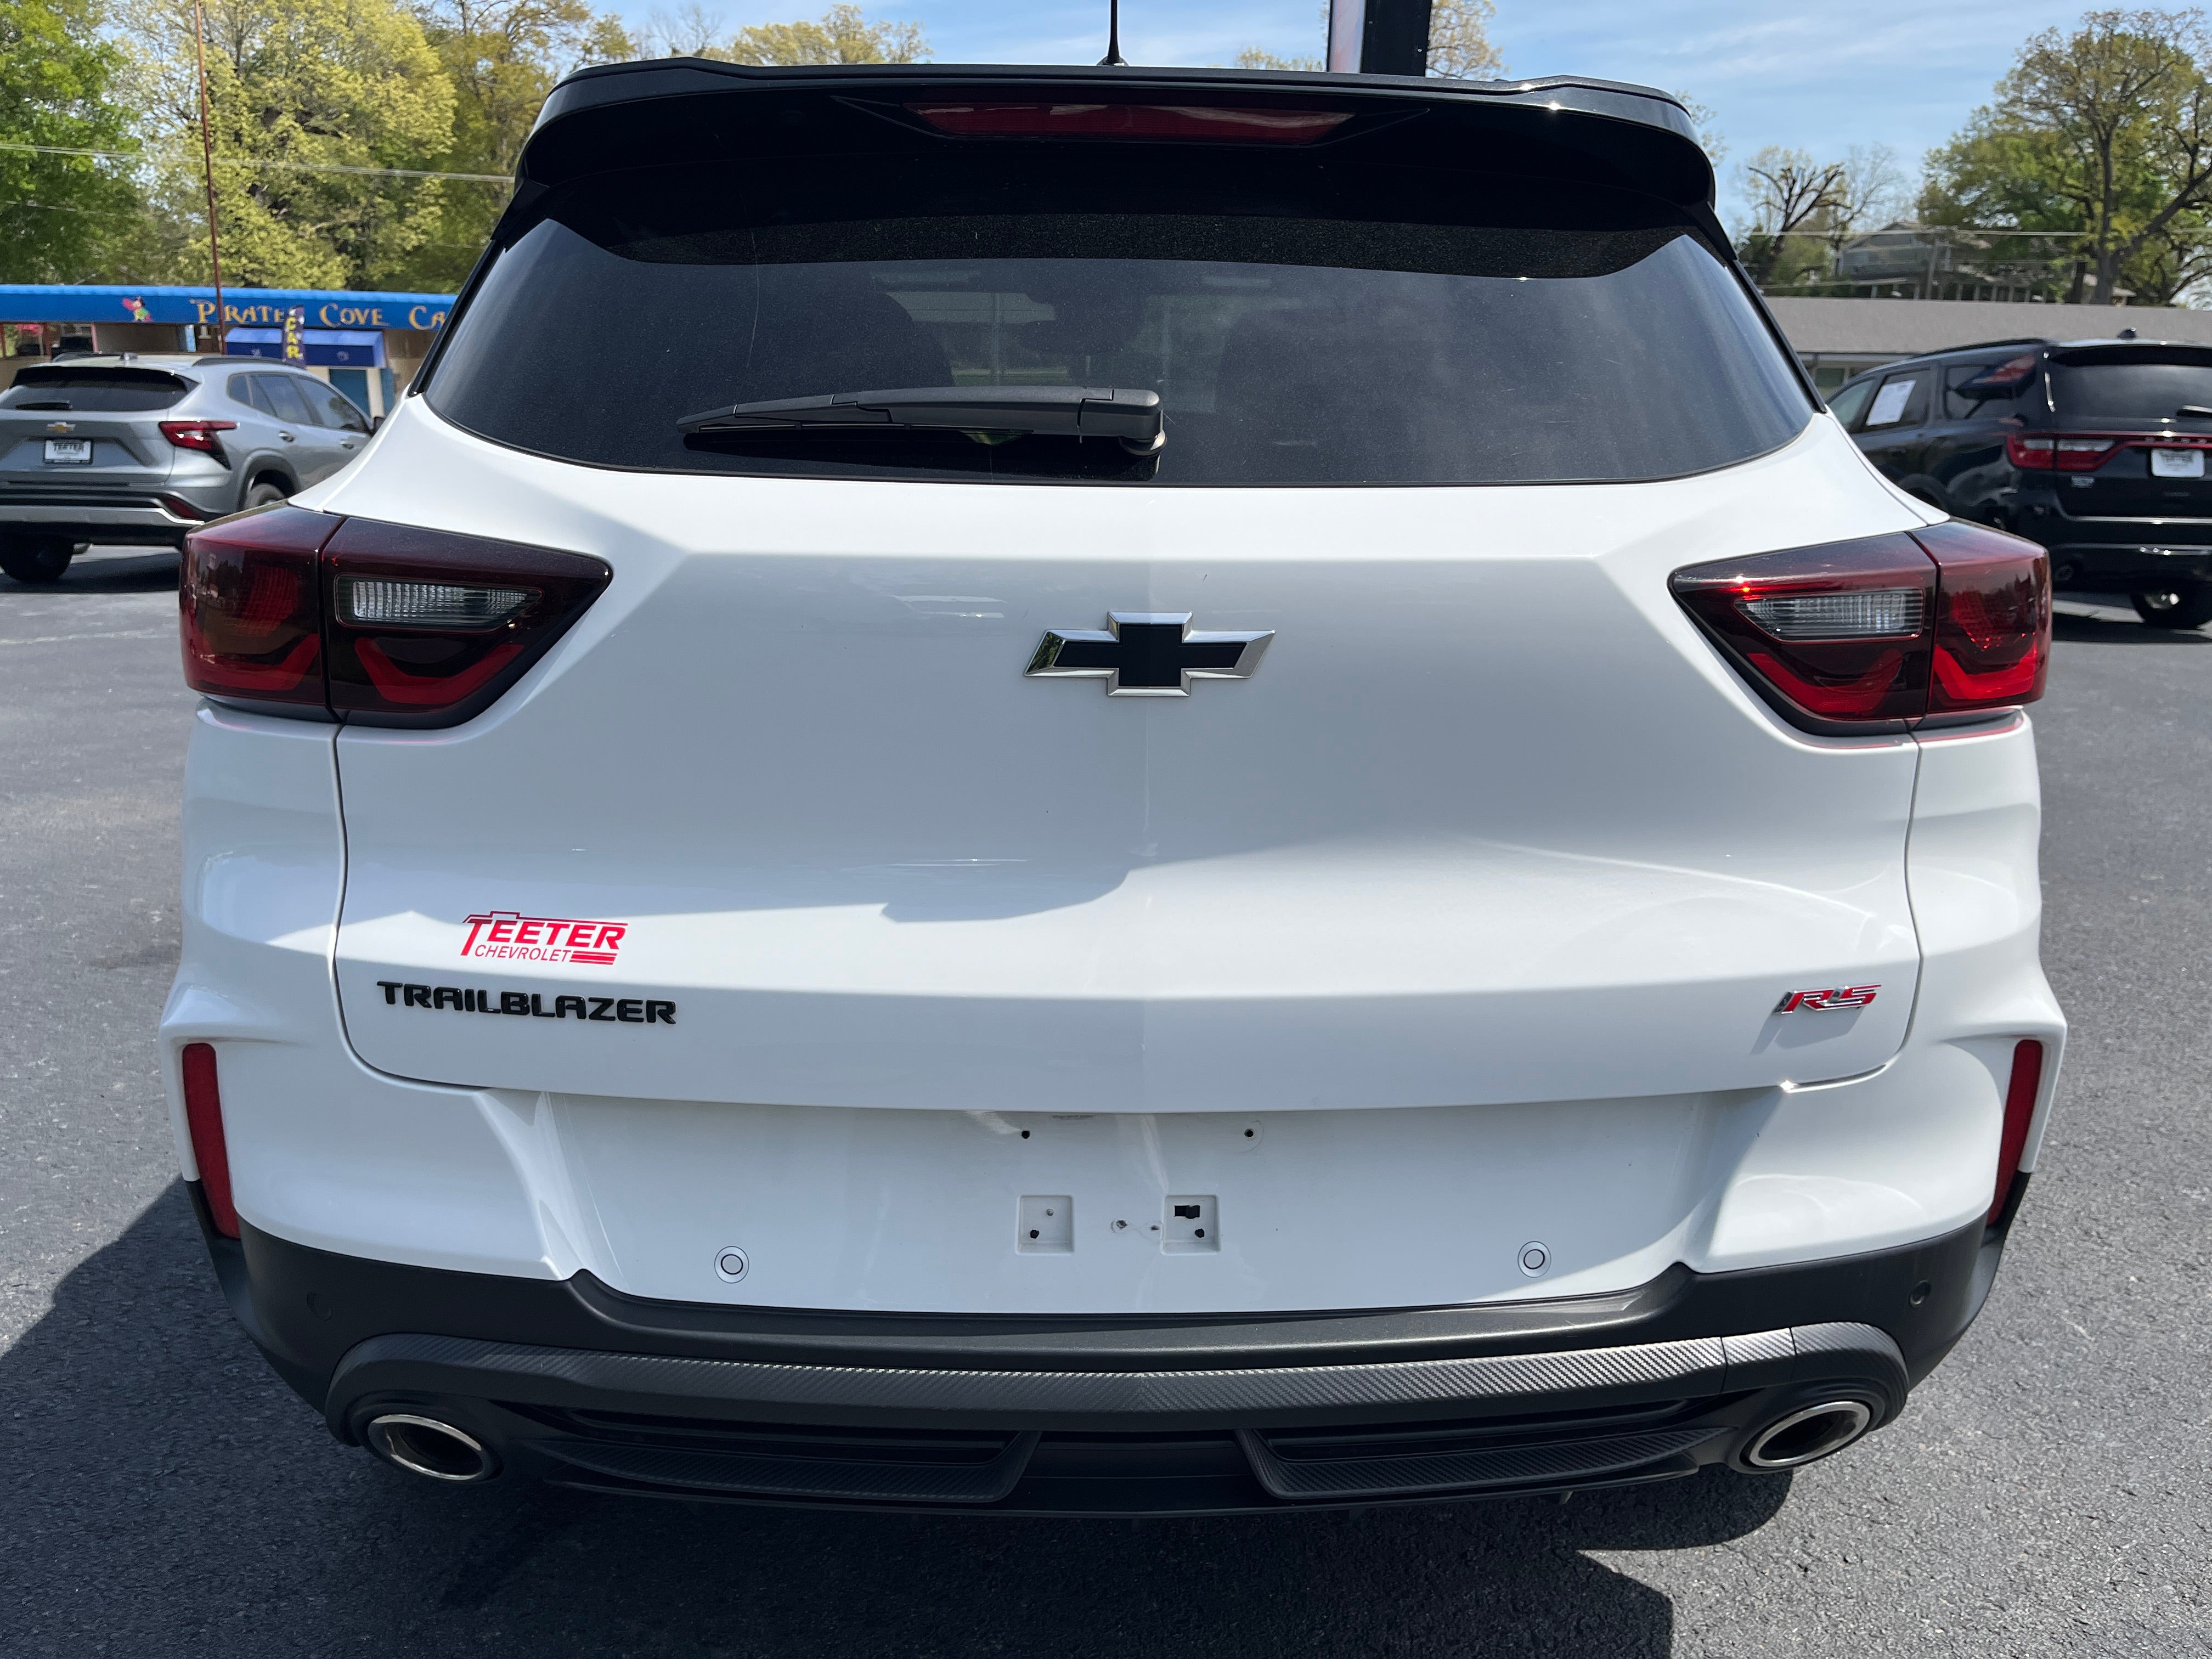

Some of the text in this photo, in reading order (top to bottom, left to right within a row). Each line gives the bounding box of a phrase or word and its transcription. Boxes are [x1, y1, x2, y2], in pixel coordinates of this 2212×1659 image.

[319, 302, 390, 328] COVE
[285, 316, 300, 359] CAR
[460, 918, 627, 956] TEETER
[475, 944, 572, 963] CHEVROLET
[376, 980, 676, 1025] TRAILBLAZER
[1772, 983, 1882, 1014] RS
